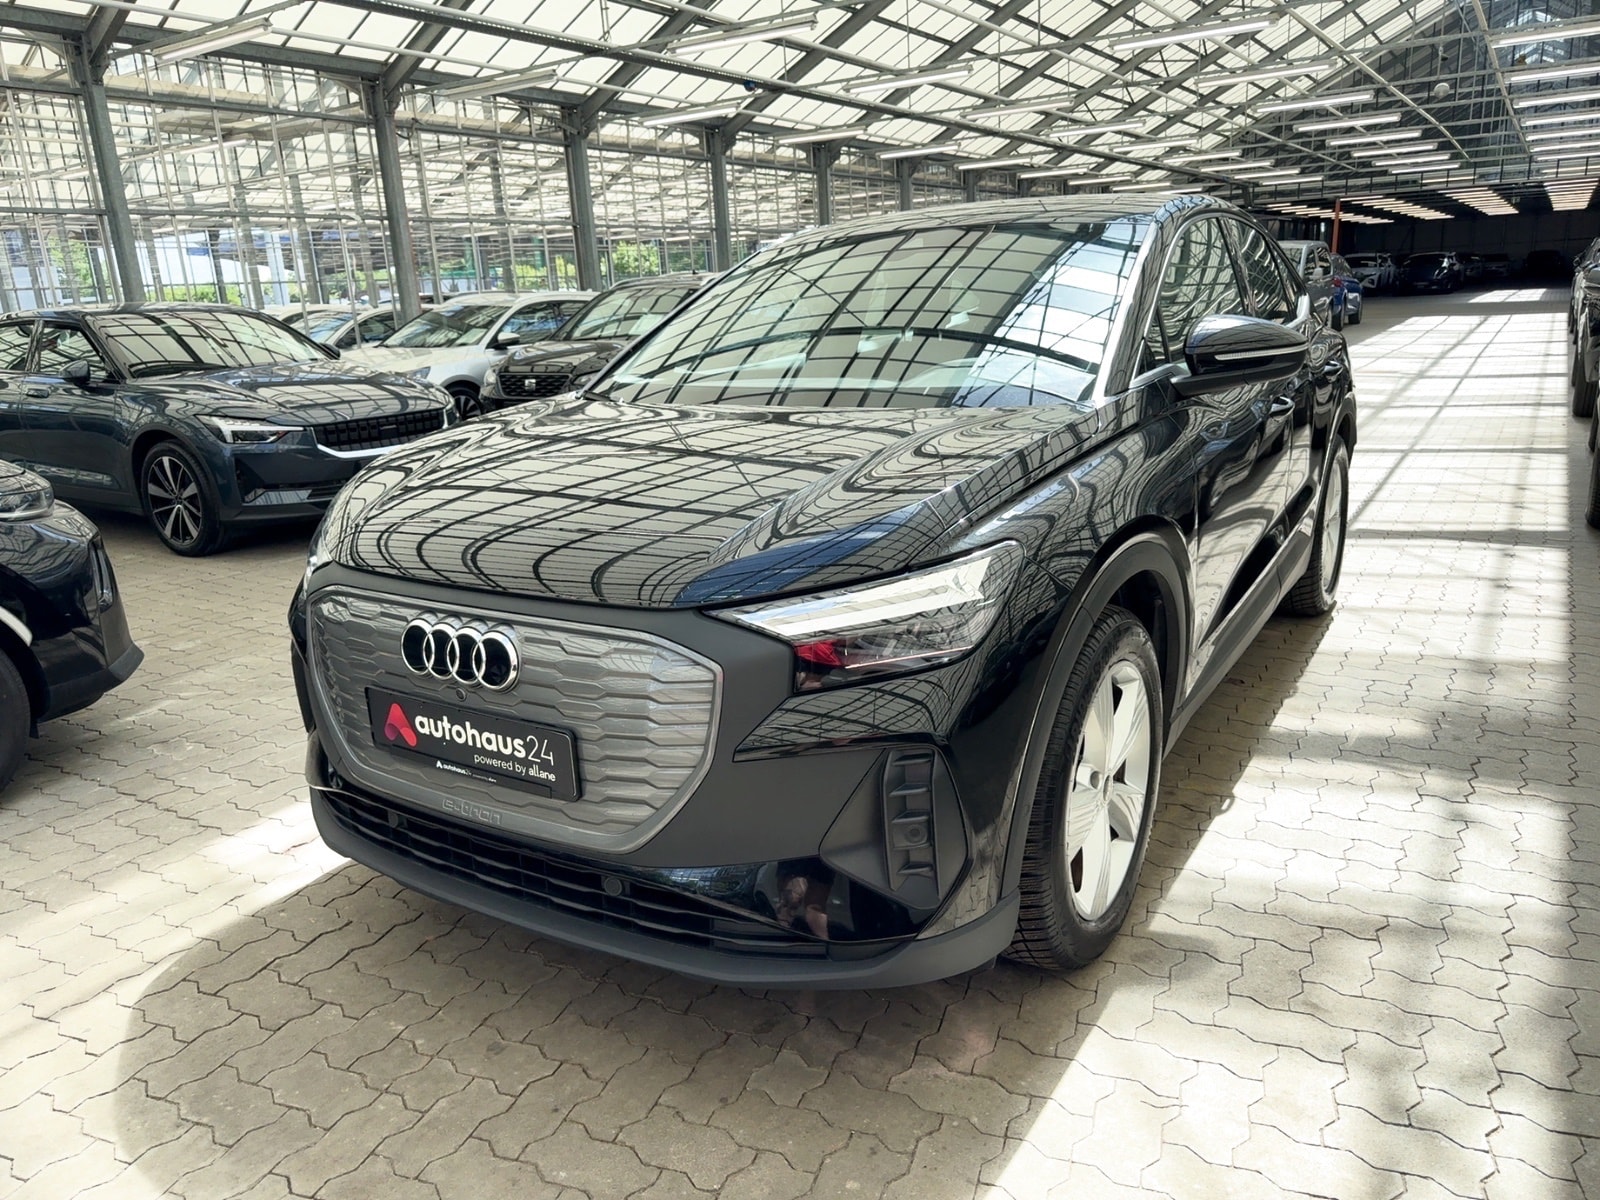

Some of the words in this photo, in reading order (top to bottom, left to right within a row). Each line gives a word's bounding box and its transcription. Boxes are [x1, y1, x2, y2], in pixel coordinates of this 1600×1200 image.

[414, 715, 554, 766] autohaus24
[474, 754, 513, 771] powered
[514, 762, 527, 776] by
[528, 764, 556, 782] allane
